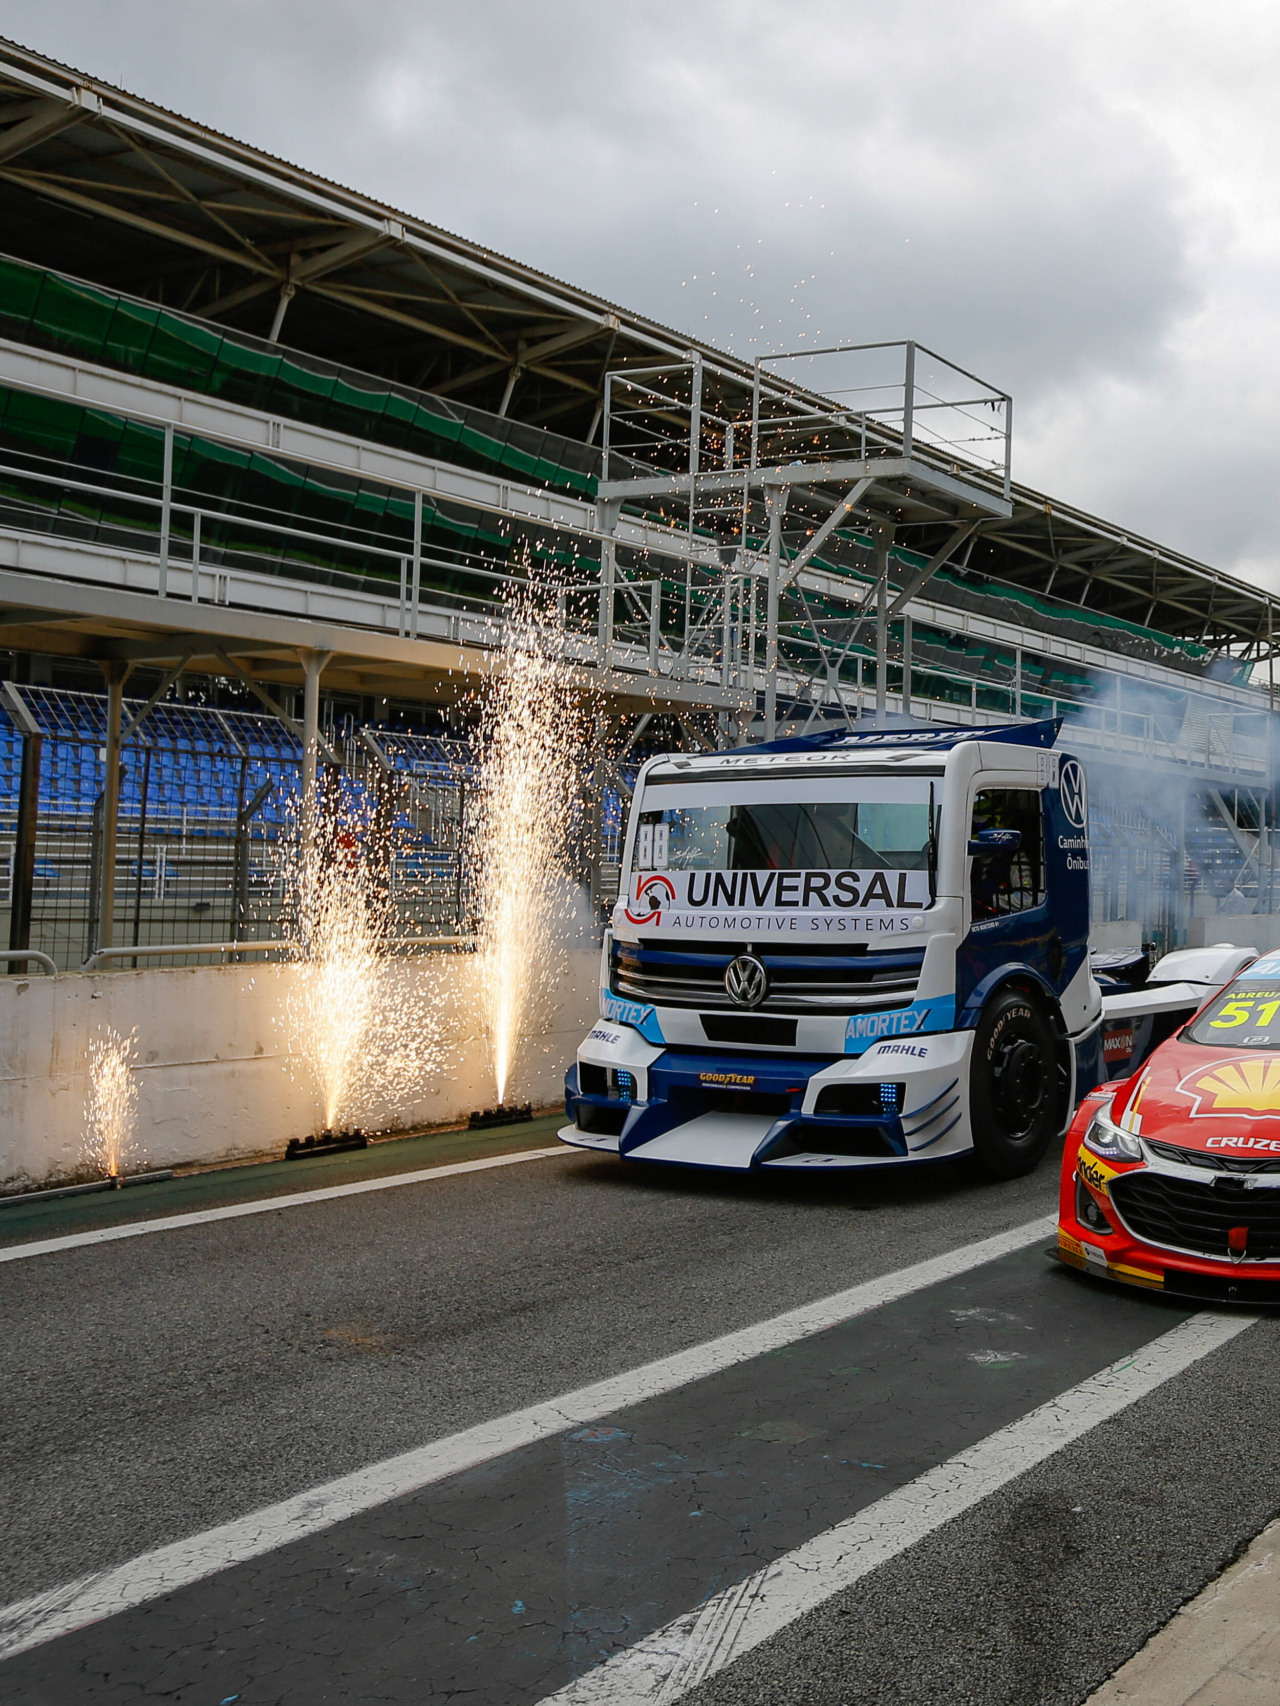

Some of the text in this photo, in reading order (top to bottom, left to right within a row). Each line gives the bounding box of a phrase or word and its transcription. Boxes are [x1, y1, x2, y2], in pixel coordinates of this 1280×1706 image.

[720, 753, 851, 765] METEOR
[687, 871, 924, 909] UNIVERSAL
[672, 916, 910, 931] AUTOMOTIVE SYSTEMS
[846, 1009, 930, 1040] AMORTEX
[589, 1030, 621, 1044] MAHLE
[877, 1044, 929, 1059] MAHLE
[700, 1072, 756, 1084] GOODYEAR
